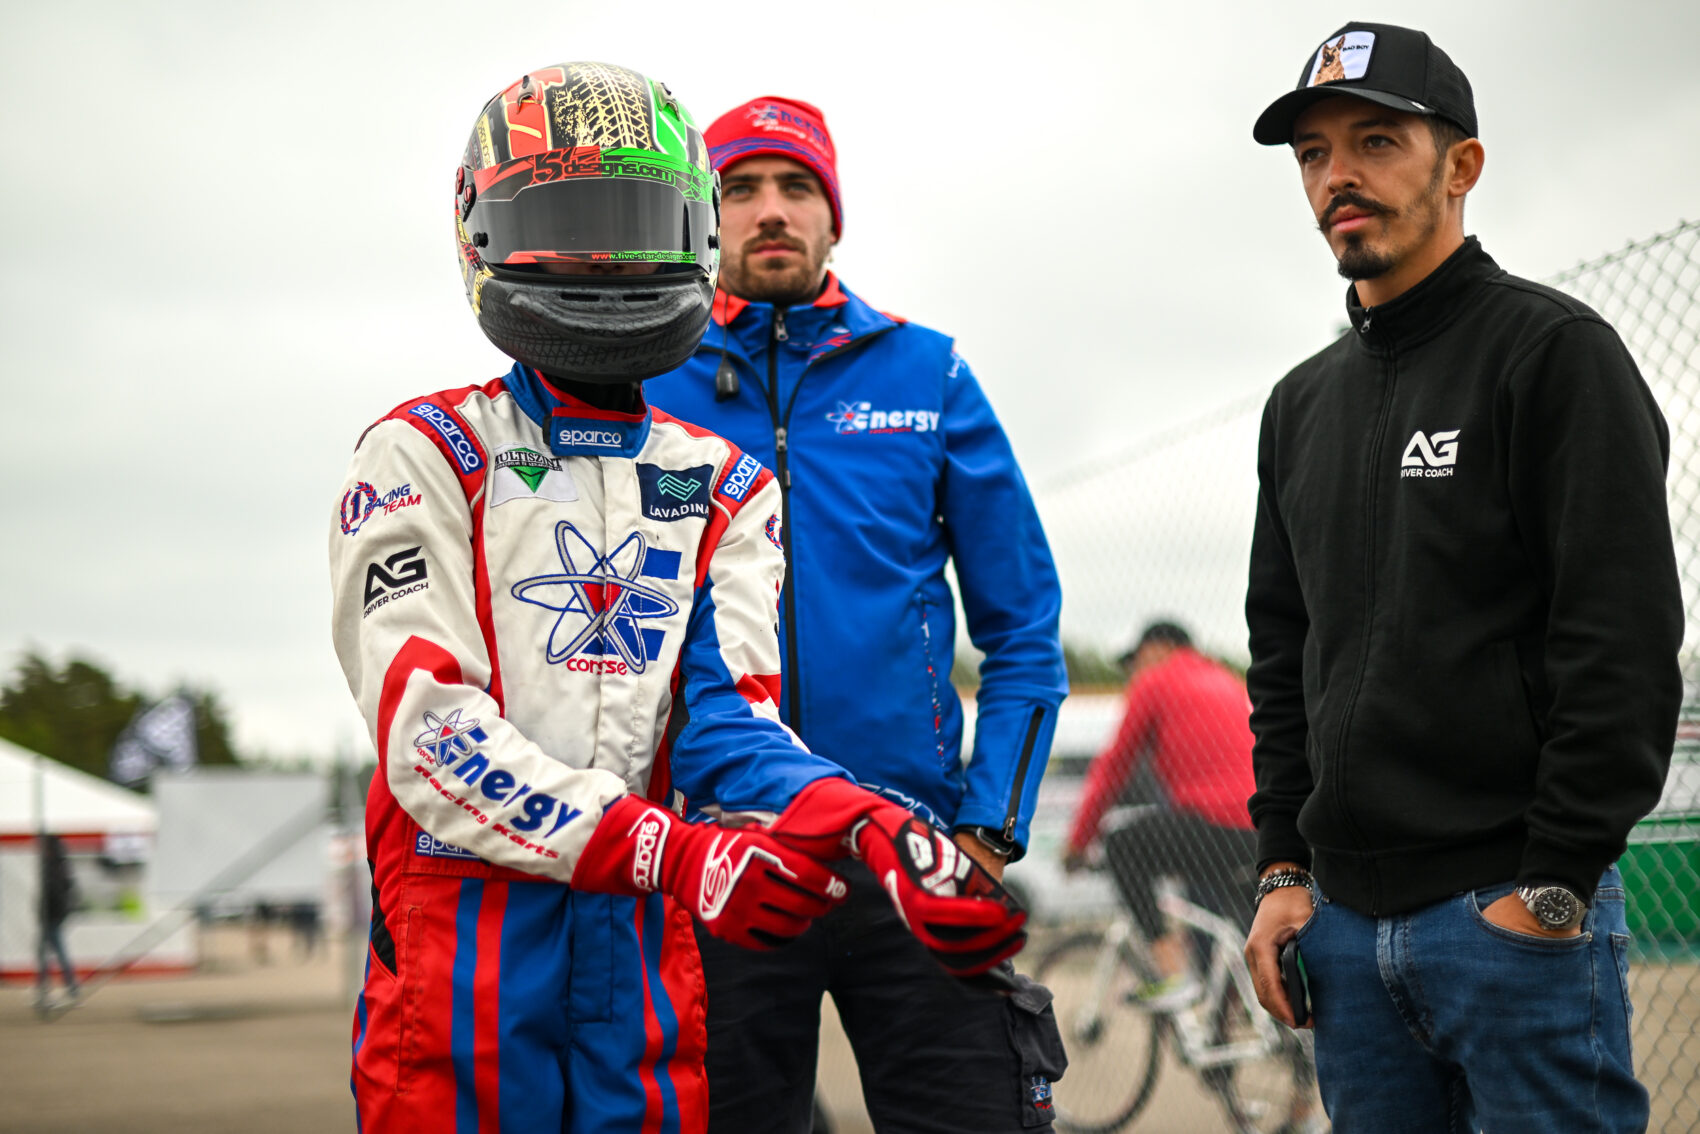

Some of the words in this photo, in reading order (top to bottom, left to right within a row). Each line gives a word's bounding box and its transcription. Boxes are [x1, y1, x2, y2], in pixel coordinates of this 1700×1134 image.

[417, 404, 479, 469] sparco
[559, 429, 622, 447] sparco
[1401, 429, 1461, 467] AG
[724, 453, 758, 496] sparc
[1424, 467, 1453, 478] COACH
[364, 483, 411, 514] RACING
[384, 494, 422, 516] TEAM
[363, 545, 428, 610] AG
[363, 595, 389, 619] DRIVER
[391, 581, 429, 600] COACH
[416, 747, 436, 765] corse
[426, 725, 583, 839] Energy
[491, 822, 560, 859] karts
[636, 821, 660, 892] sparc
